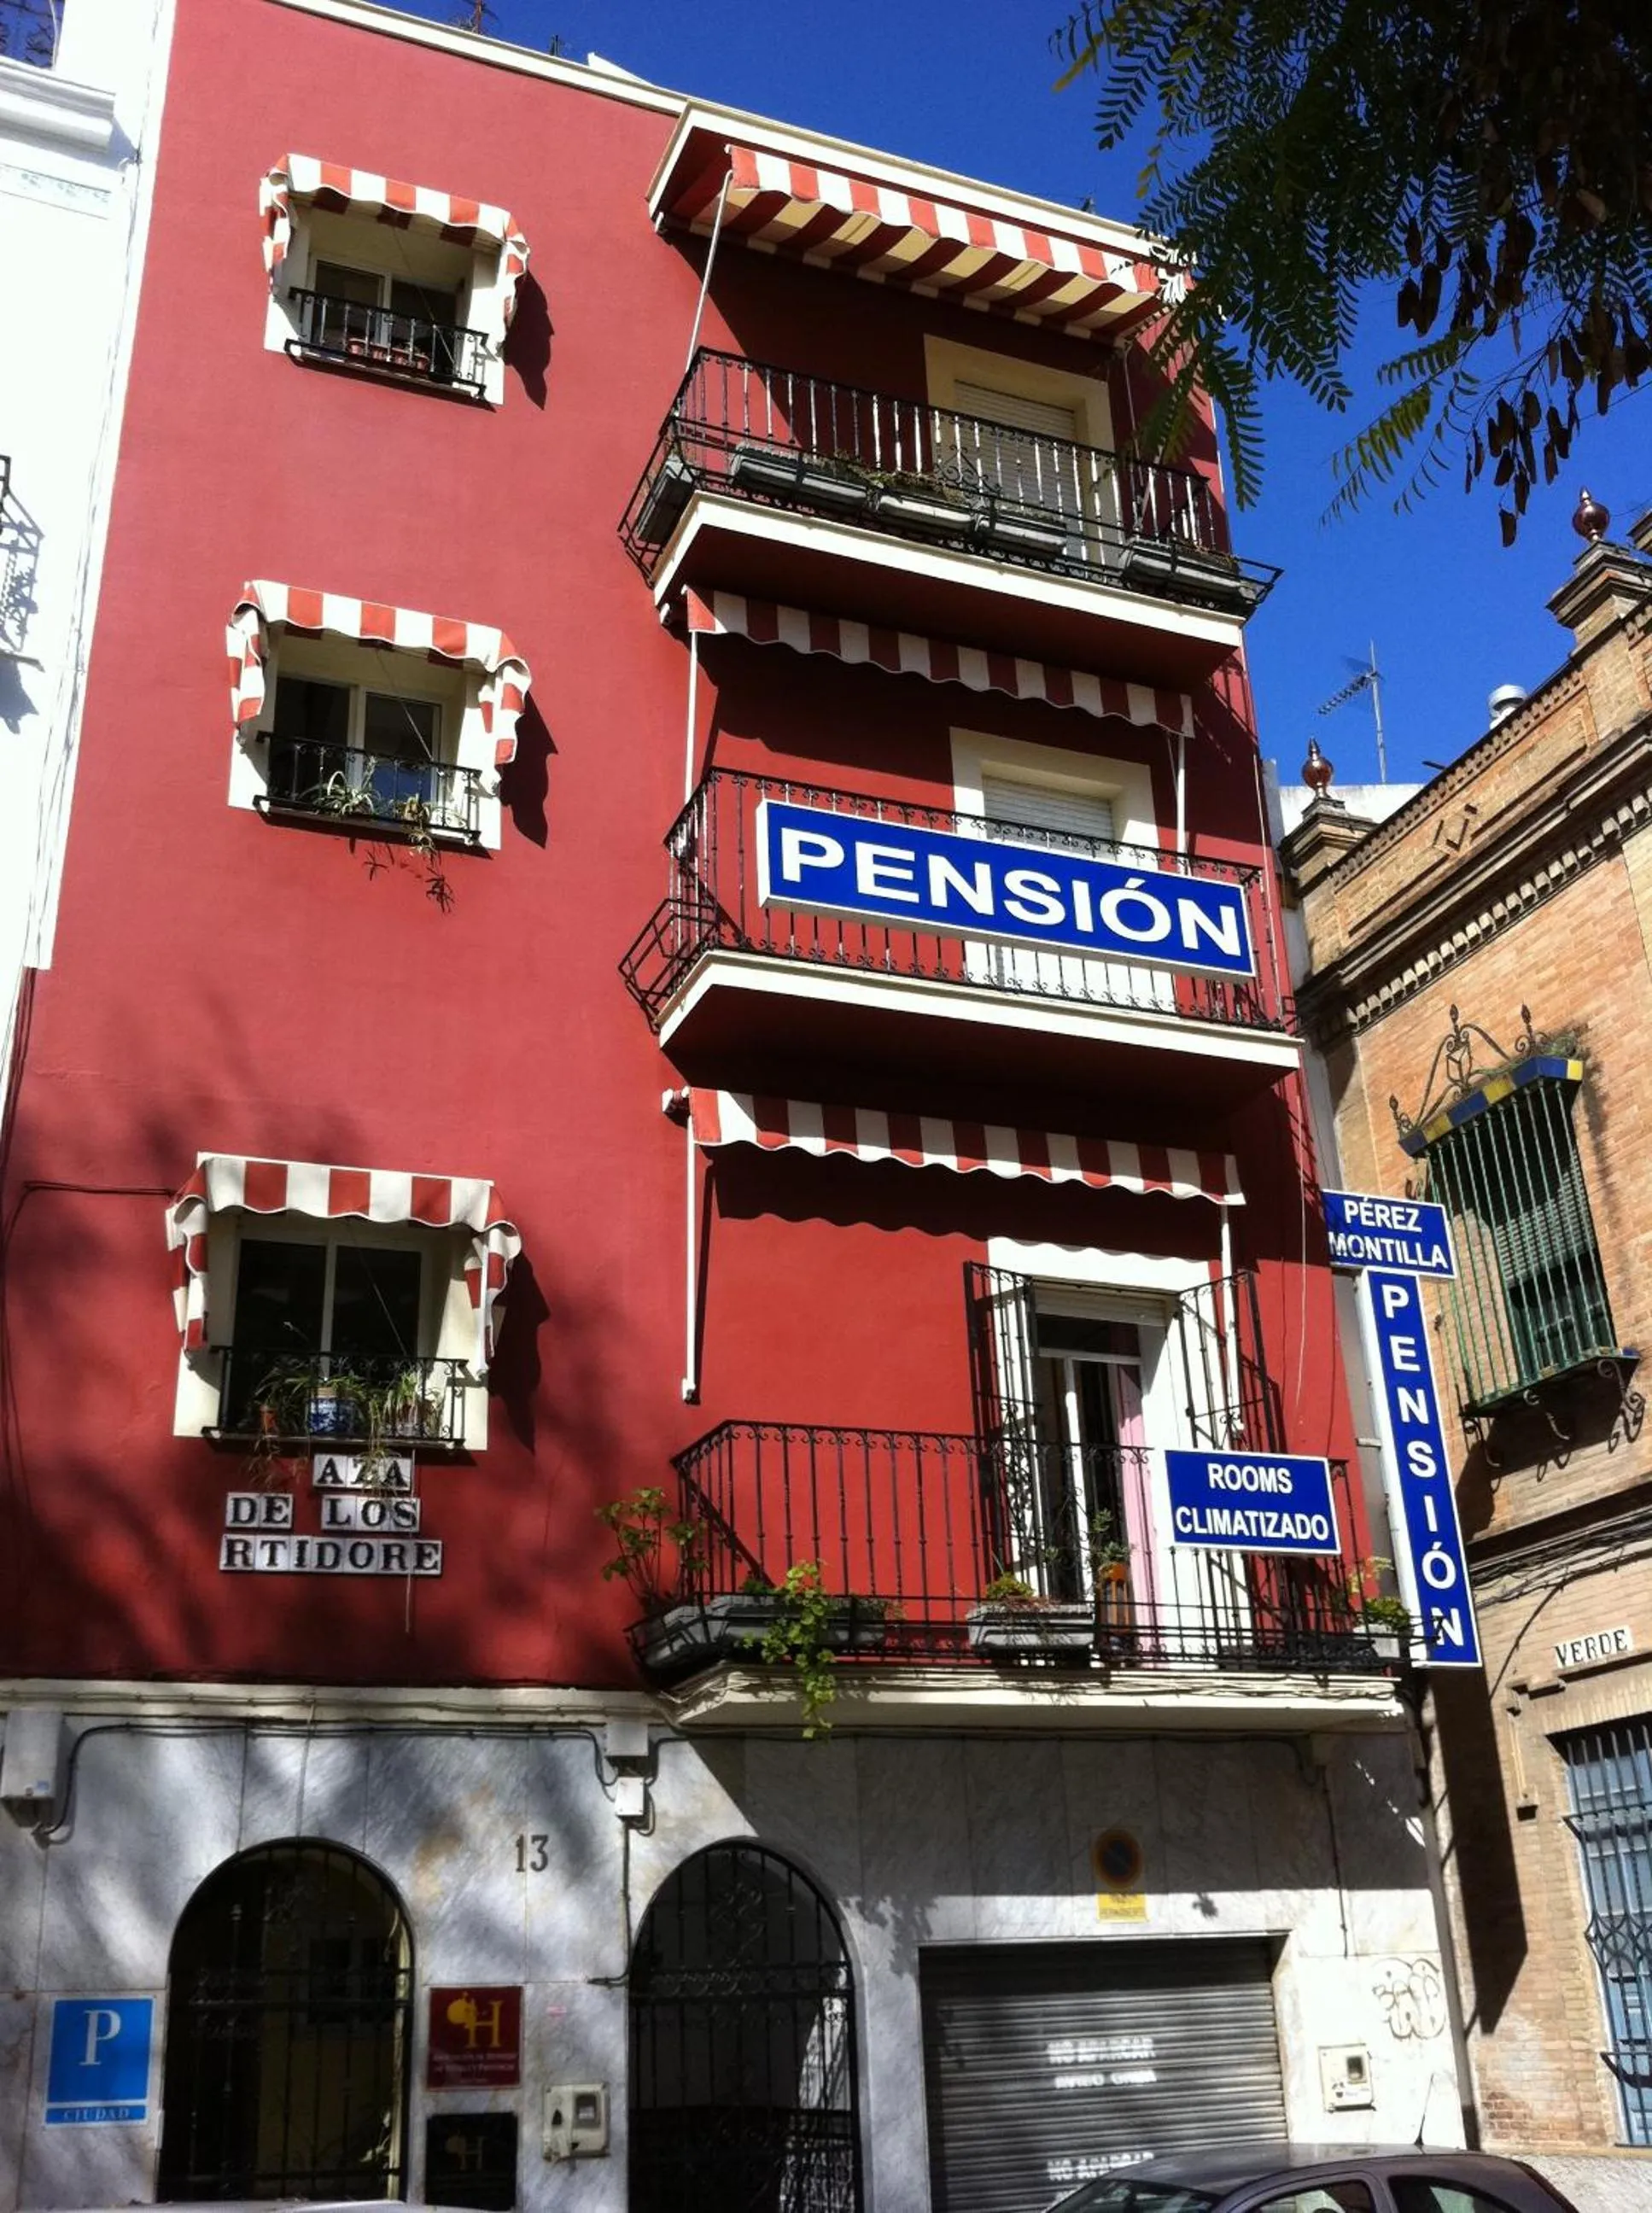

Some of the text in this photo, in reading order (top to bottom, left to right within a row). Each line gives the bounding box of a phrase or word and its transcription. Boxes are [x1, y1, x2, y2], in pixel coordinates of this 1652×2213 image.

[781, 827, 1241, 956] PENSIÓN
[1344, 1197, 1421, 1232] PÉREZ
[1328, 1231, 1448, 1269] MONTILLA
[1207, 1463, 1293, 1494] ROOMS
[1381, 1284, 1464, 1647] PENSIÓN
[231, 1496, 417, 1528] DE LOS
[1176, 1506, 1328, 1540] CLIMATIZADO
[224, 1539, 440, 1571] RTIDORE
[1555, 1629, 1627, 1666] VERDE
[516, 1834, 548, 1872] 13
[79, 2010, 120, 2065] P
[63, 2107, 130, 2121] CIUDAD
